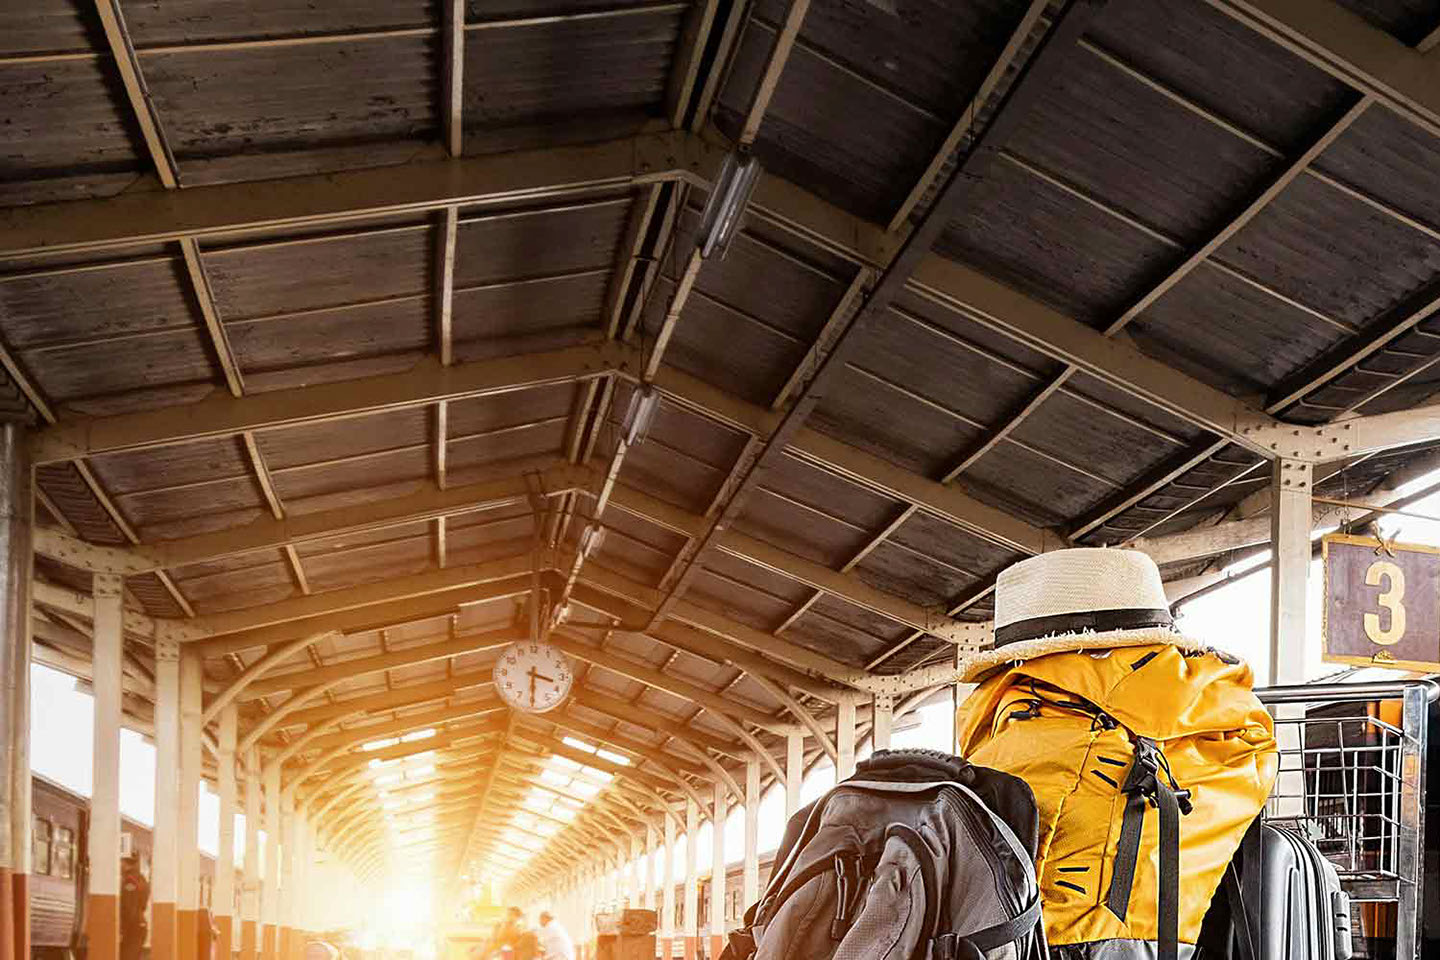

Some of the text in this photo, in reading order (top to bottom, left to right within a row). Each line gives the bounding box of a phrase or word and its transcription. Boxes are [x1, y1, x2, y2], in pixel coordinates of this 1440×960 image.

[1363, 560, 1406, 646] 3
[555, 660, 562, 669] 2
[559, 673, 565, 681] 3
